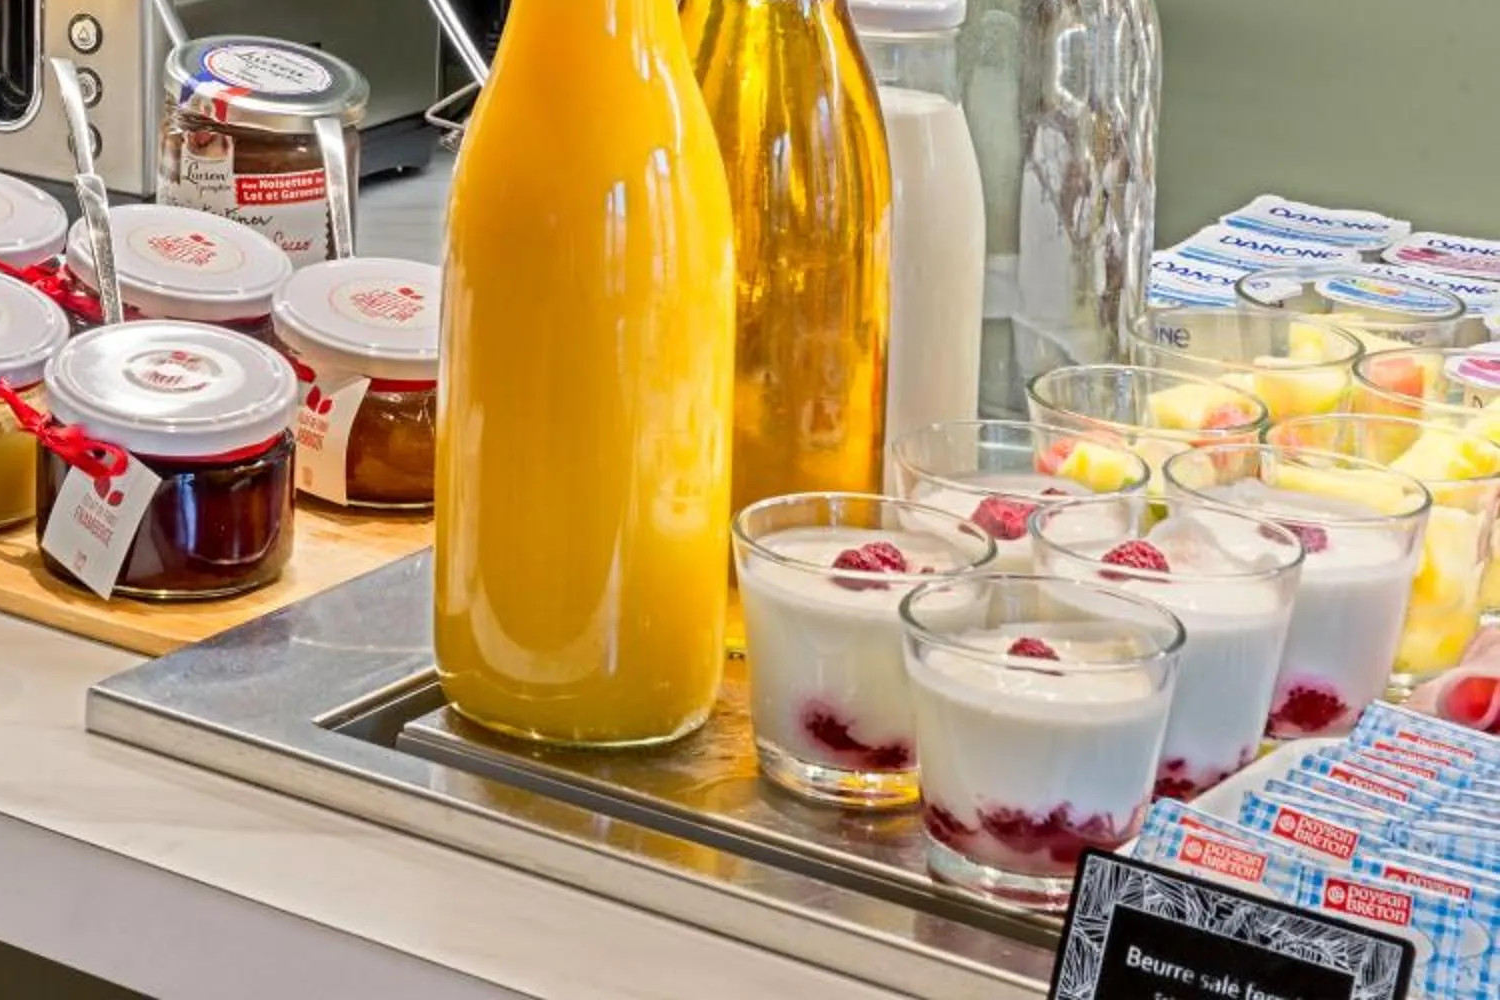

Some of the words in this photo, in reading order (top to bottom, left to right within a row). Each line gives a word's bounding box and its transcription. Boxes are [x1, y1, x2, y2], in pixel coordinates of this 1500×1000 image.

[259, 176, 313, 190] Noisettes
[1269, 206, 1390, 232] DANONE
[1220, 234, 1343, 260] DANONE
[1347, 883, 1409, 909] paysan
[1126, 945, 1196, 984] Beurre
